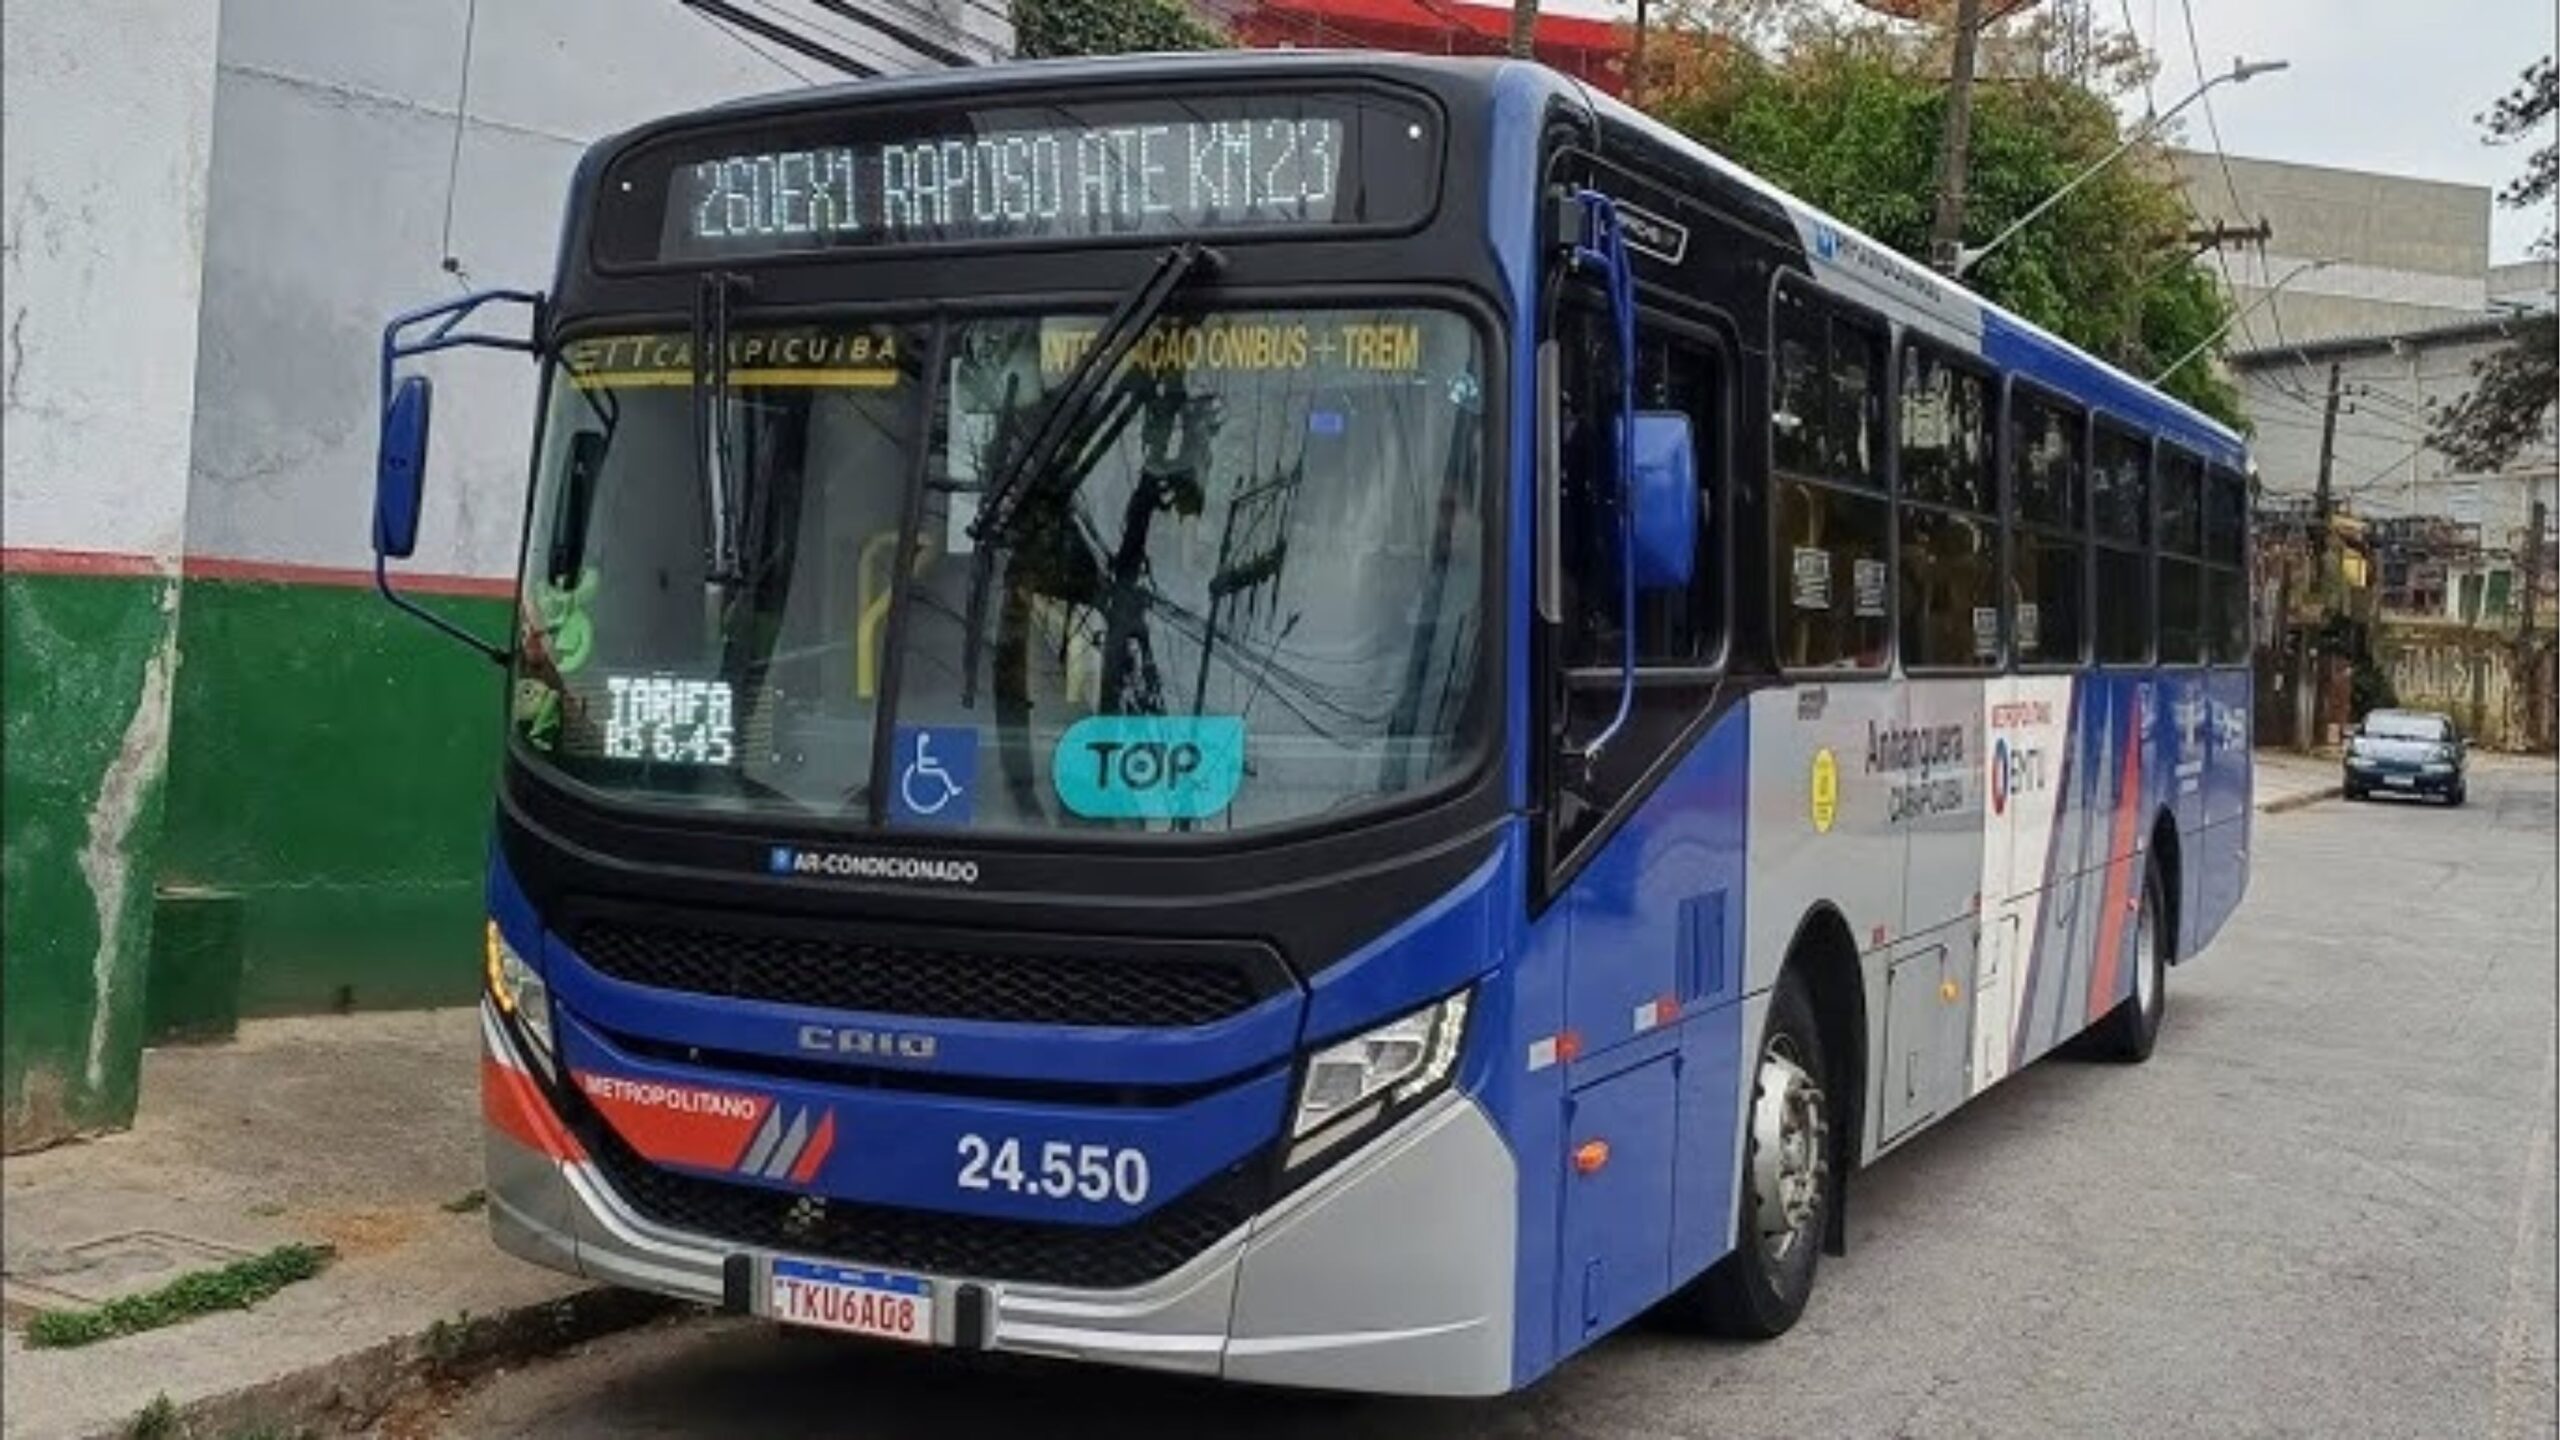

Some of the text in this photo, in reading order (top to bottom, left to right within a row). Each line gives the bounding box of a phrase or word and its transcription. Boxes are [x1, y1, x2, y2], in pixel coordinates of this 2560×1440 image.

[884, 134, 1061, 229] RAPOSO
[1078, 126, 1171, 215] ATE
[1190, 118, 1329, 208] KM.23
[1342, 323, 1419, 371] TREM
[607, 677, 732, 723] TARIFA
[1085, 741, 1202, 791] TOP
[794, 852, 979, 884] AR-CONDICIONADO
[800, 1025, 936, 1057] CAIO
[584, 1074, 756, 1120] METROPOLITANO
[957, 1133, 1149, 1204] 24.550
[787, 1278, 915, 1333] TKU6A08
